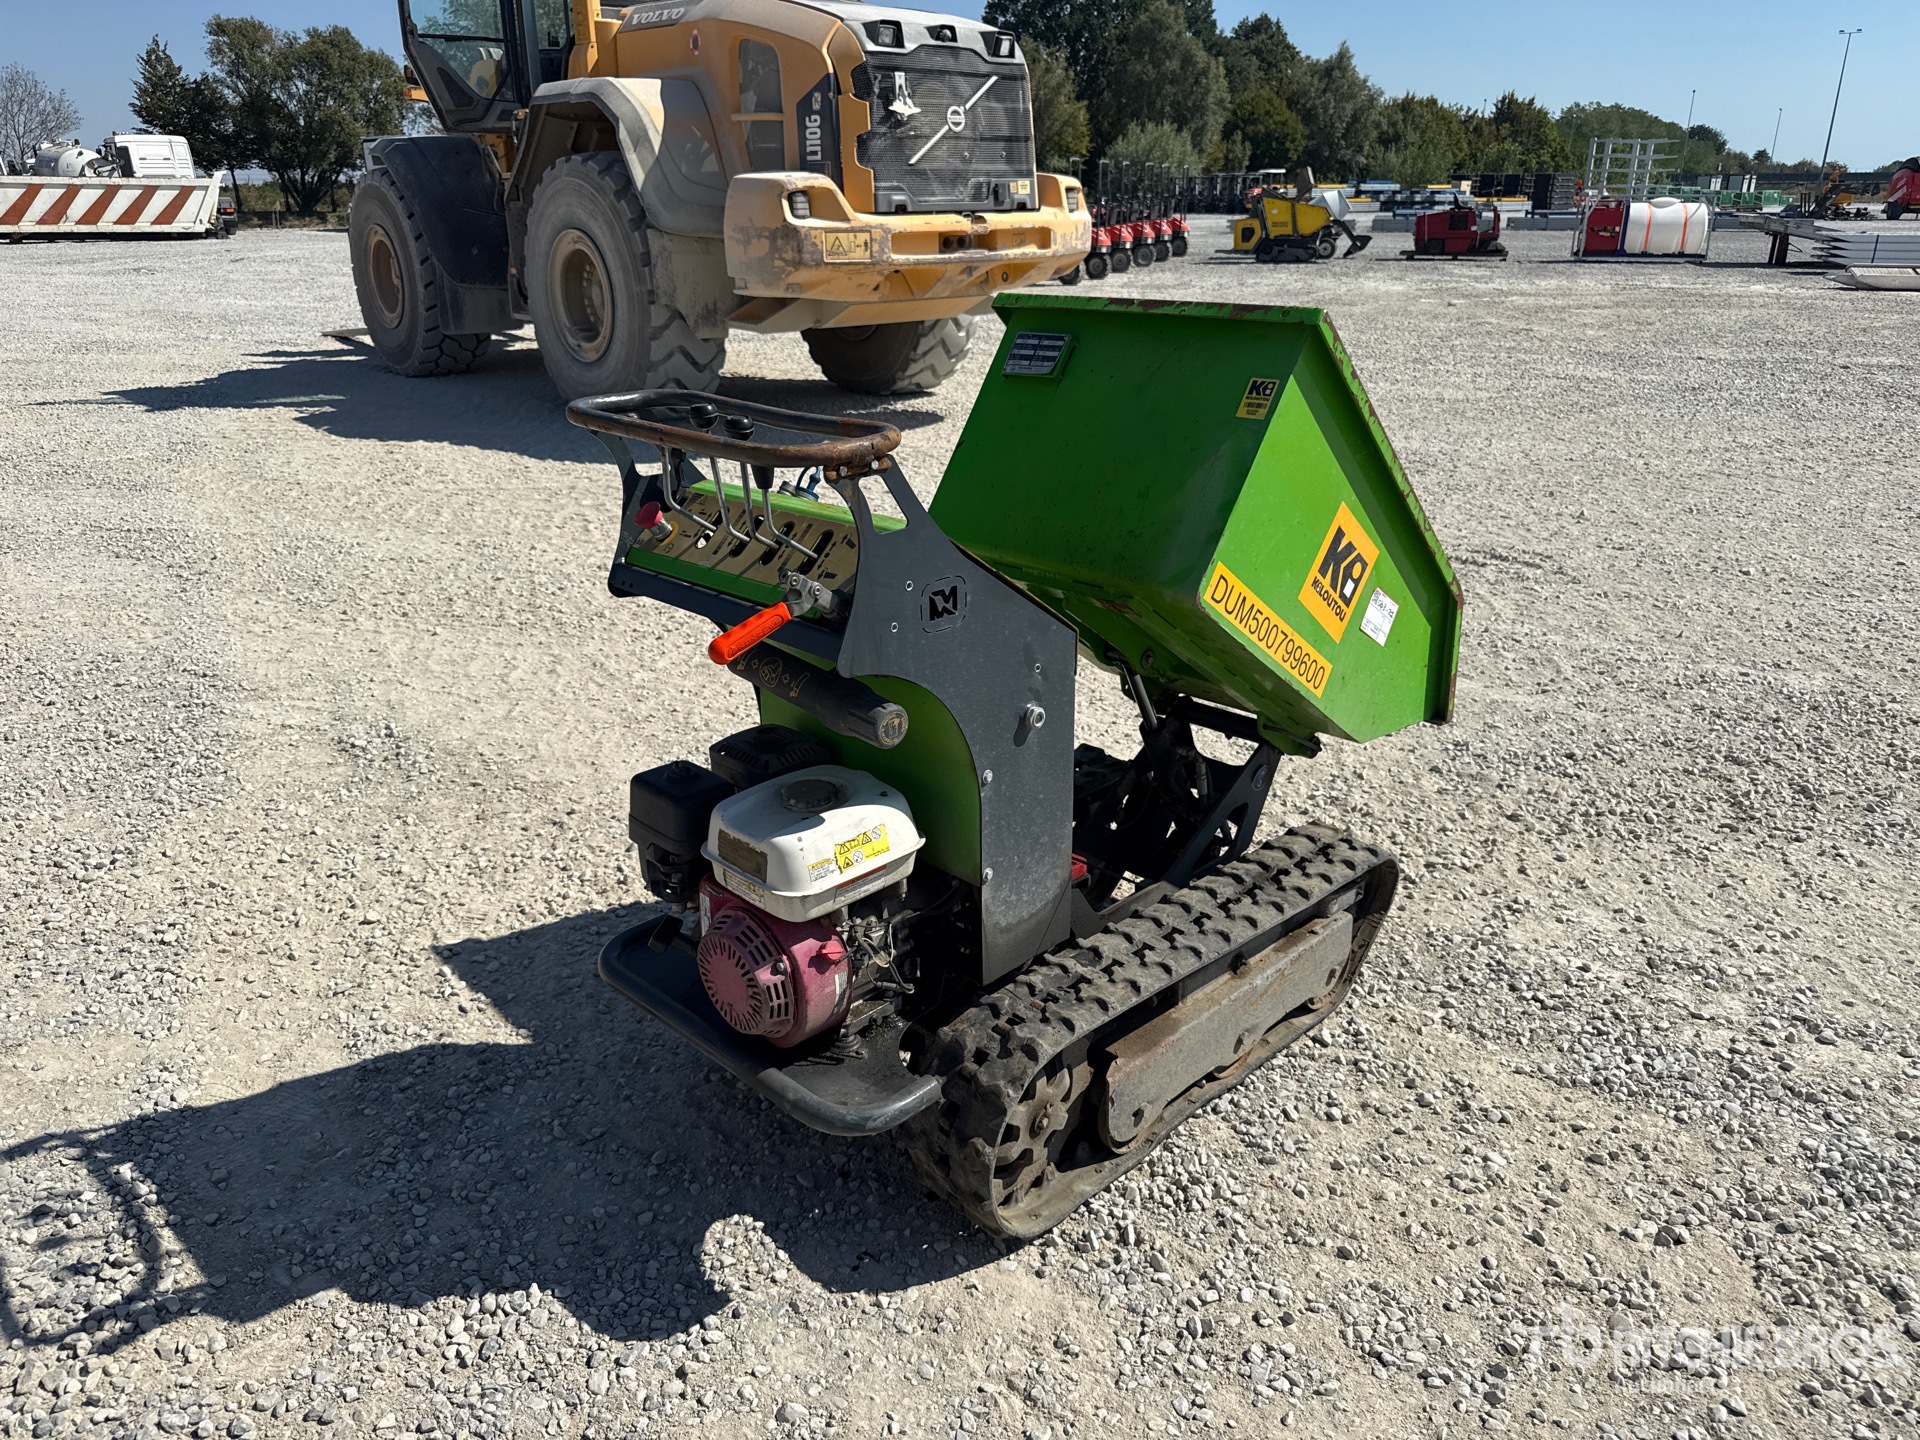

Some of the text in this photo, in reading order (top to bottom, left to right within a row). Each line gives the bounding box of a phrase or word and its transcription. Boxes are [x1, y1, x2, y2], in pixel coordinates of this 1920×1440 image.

[632, 8, 685, 25] VOLVO
[805, 114, 822, 161] L110G
[1210, 573, 1326, 690] DUM500799600
